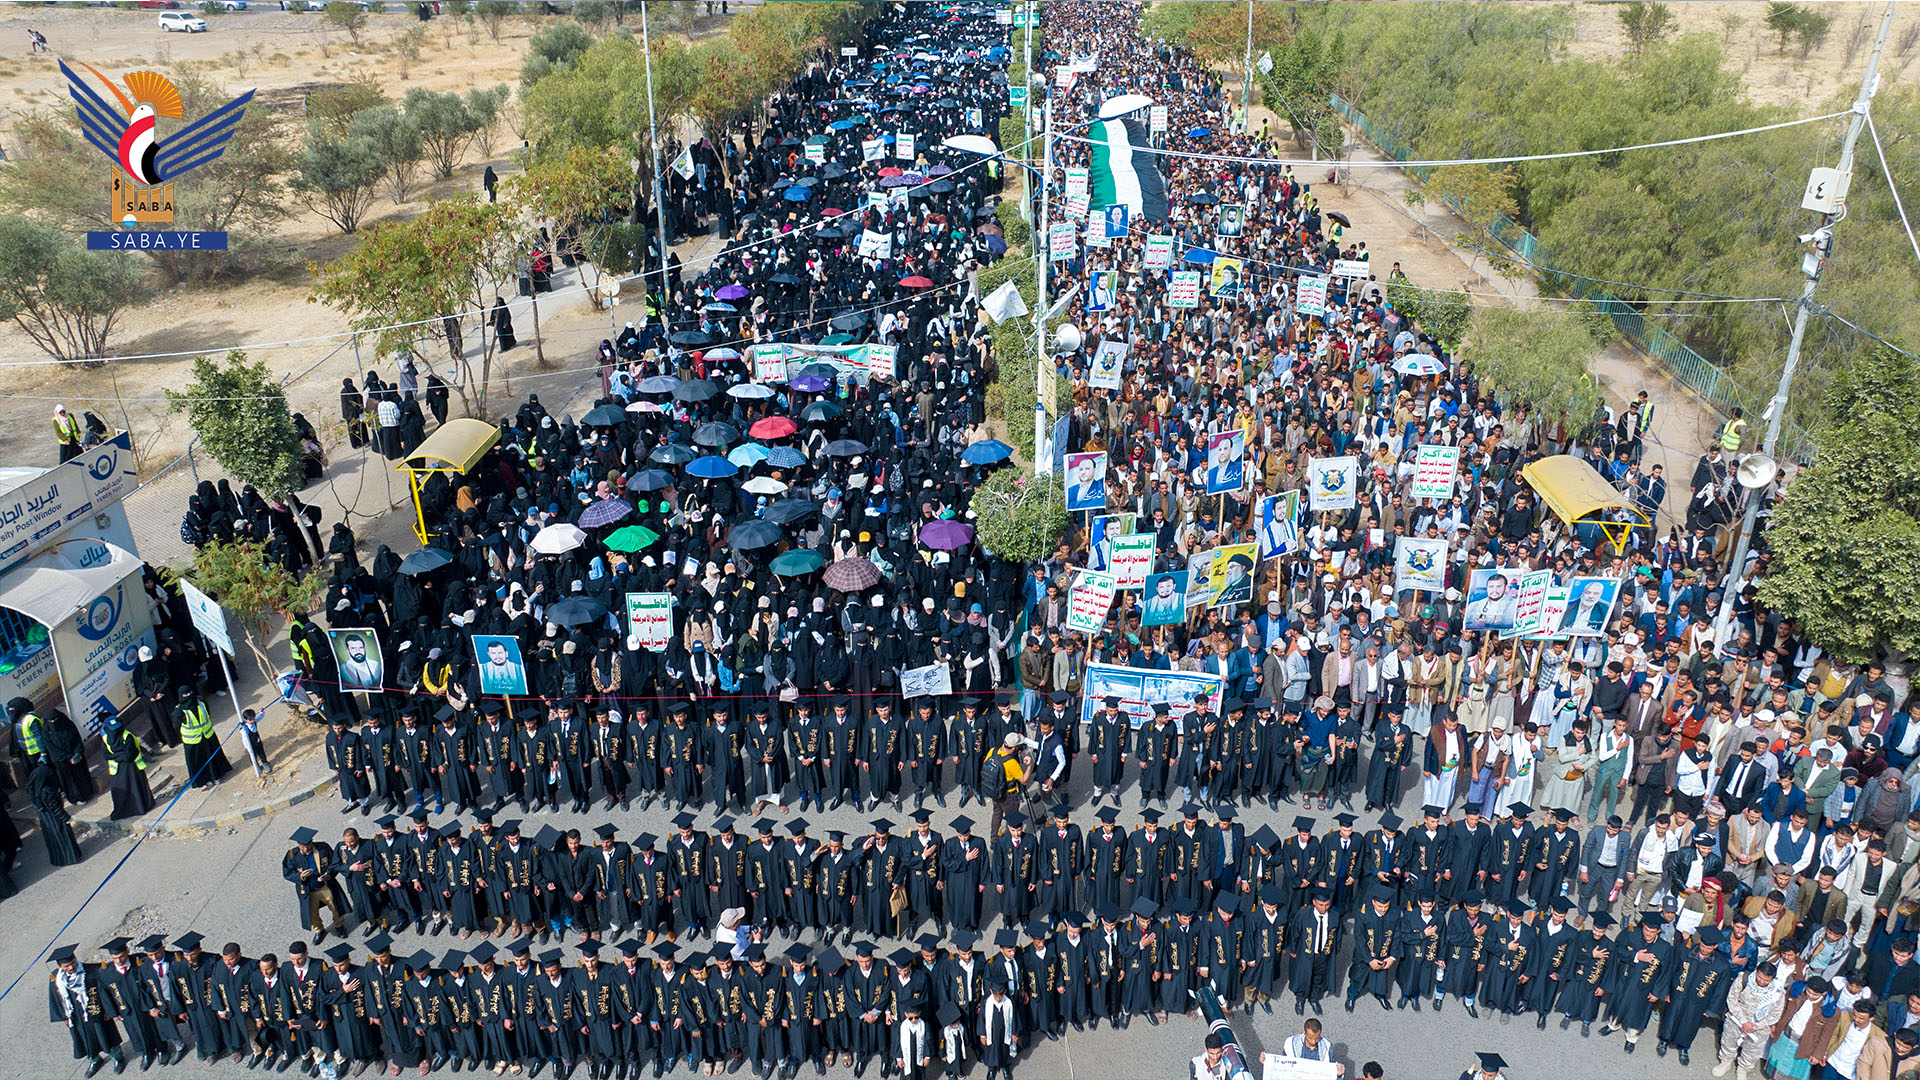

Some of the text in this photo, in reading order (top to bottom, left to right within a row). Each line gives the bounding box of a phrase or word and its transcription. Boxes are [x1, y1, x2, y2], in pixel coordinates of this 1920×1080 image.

[27, 484, 59, 512] البريد
[15, 519, 34, 533] Post
[33, 503, 62, 522] Window
[88, 634, 134, 673] YEMEN POST
[16, 659, 54, 689] YEMEN PO
[1273, 1056, 1298, 1067] Trump
